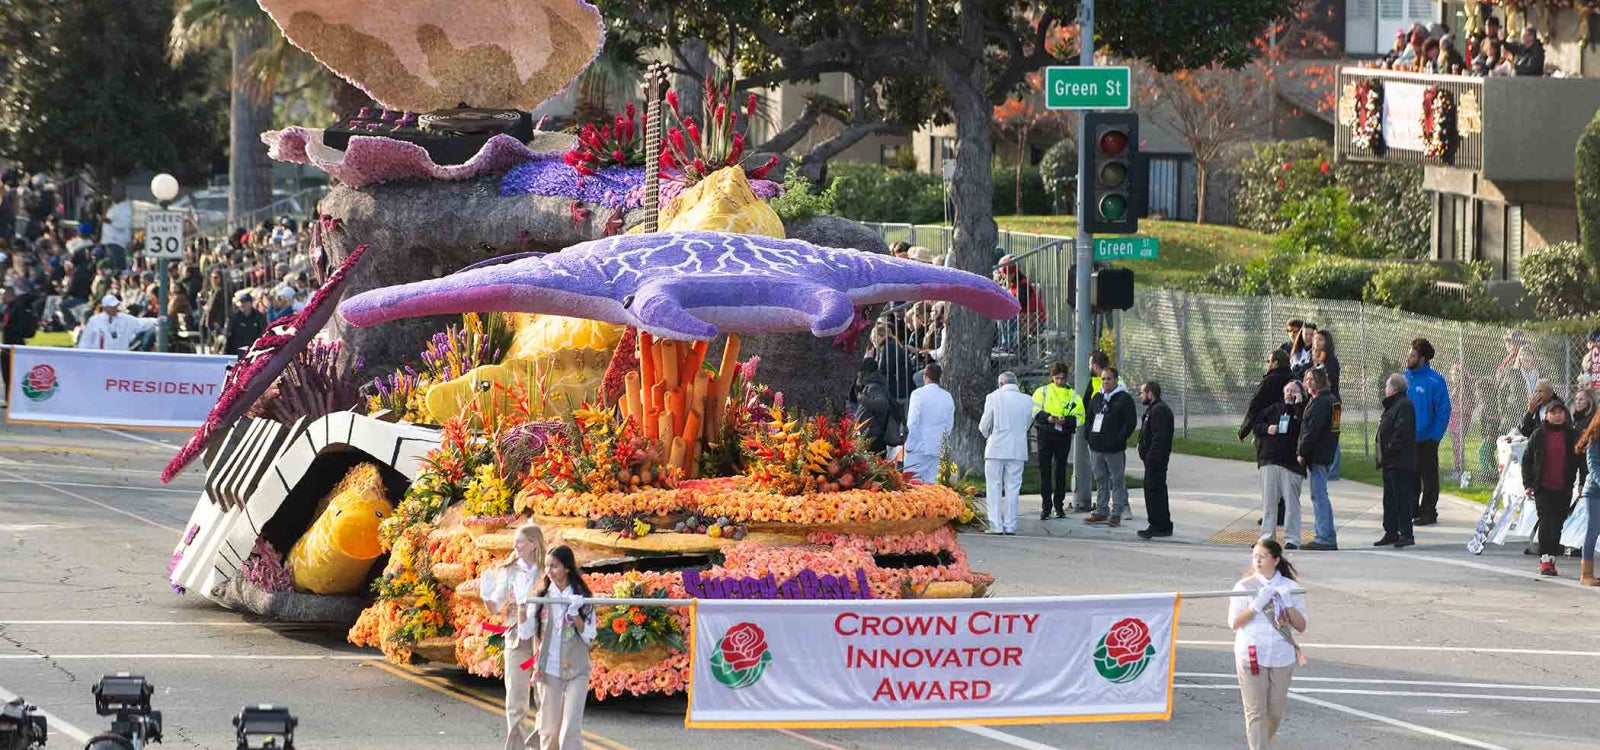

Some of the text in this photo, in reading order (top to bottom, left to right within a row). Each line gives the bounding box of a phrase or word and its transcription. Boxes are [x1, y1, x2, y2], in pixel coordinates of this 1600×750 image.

[1055, 79, 1121, 96] Green St
[148, 214, 181, 222] SPEED
[151, 224, 178, 233] LIMIT
[150, 236, 179, 253] 30
[1099, 239, 1133, 256] Green
[106, 378, 217, 395] PRESIDENT
